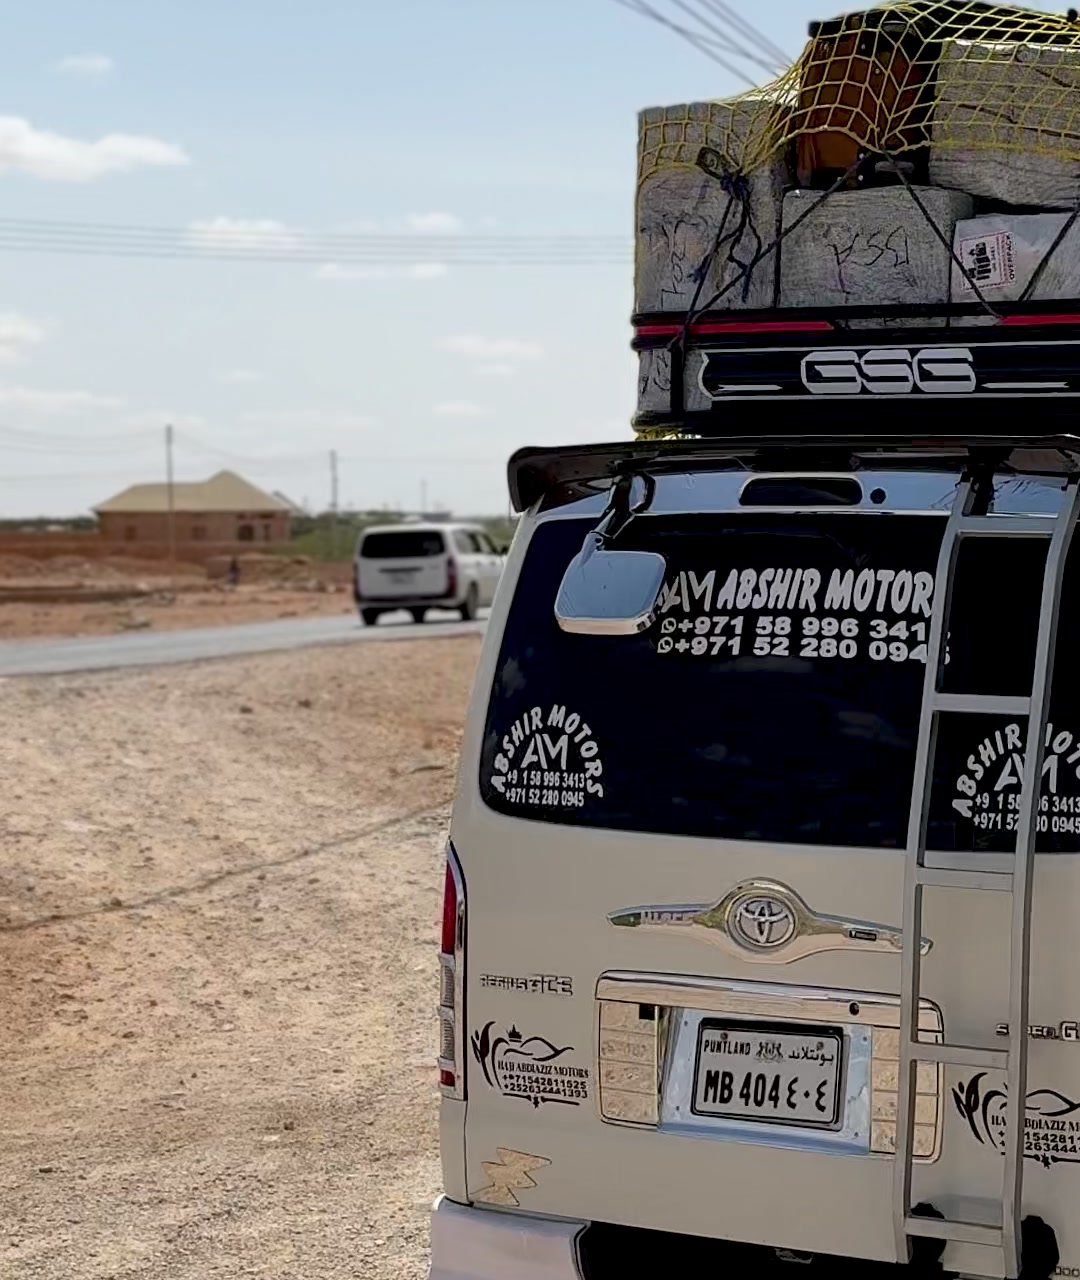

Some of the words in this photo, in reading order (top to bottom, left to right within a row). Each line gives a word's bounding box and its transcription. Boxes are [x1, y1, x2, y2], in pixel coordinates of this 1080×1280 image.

[716, 568, 821, 613] ABSHIR
[823, 568, 934, 618] MOTOR
[678, 615, 744, 635] +971
[755, 615, 791, 635] 58
[801, 617, 859, 637] 996
[868, 619, 951, 642] 341
[674, 636, 742, 656] +971
[752, 637, 790, 656] 52
[799, 638, 858, 658] 280
[490, 706, 543, 793] ABSHIR
[546, 703, 604, 798] MOTORS
[562, 772, 585, 789] 3413
[951, 723, 1023, 818] ABSHIR
[561, 790, 585, 807] 0945
[973, 812, 1002, 830] +971
[703, 1039, 751, 1056] PUNTLAND
[703, 1069, 734, 1105] MB
[739, 1071, 781, 1109] 404
[1024, 1118, 1067, 1132] BDIAZIZ
